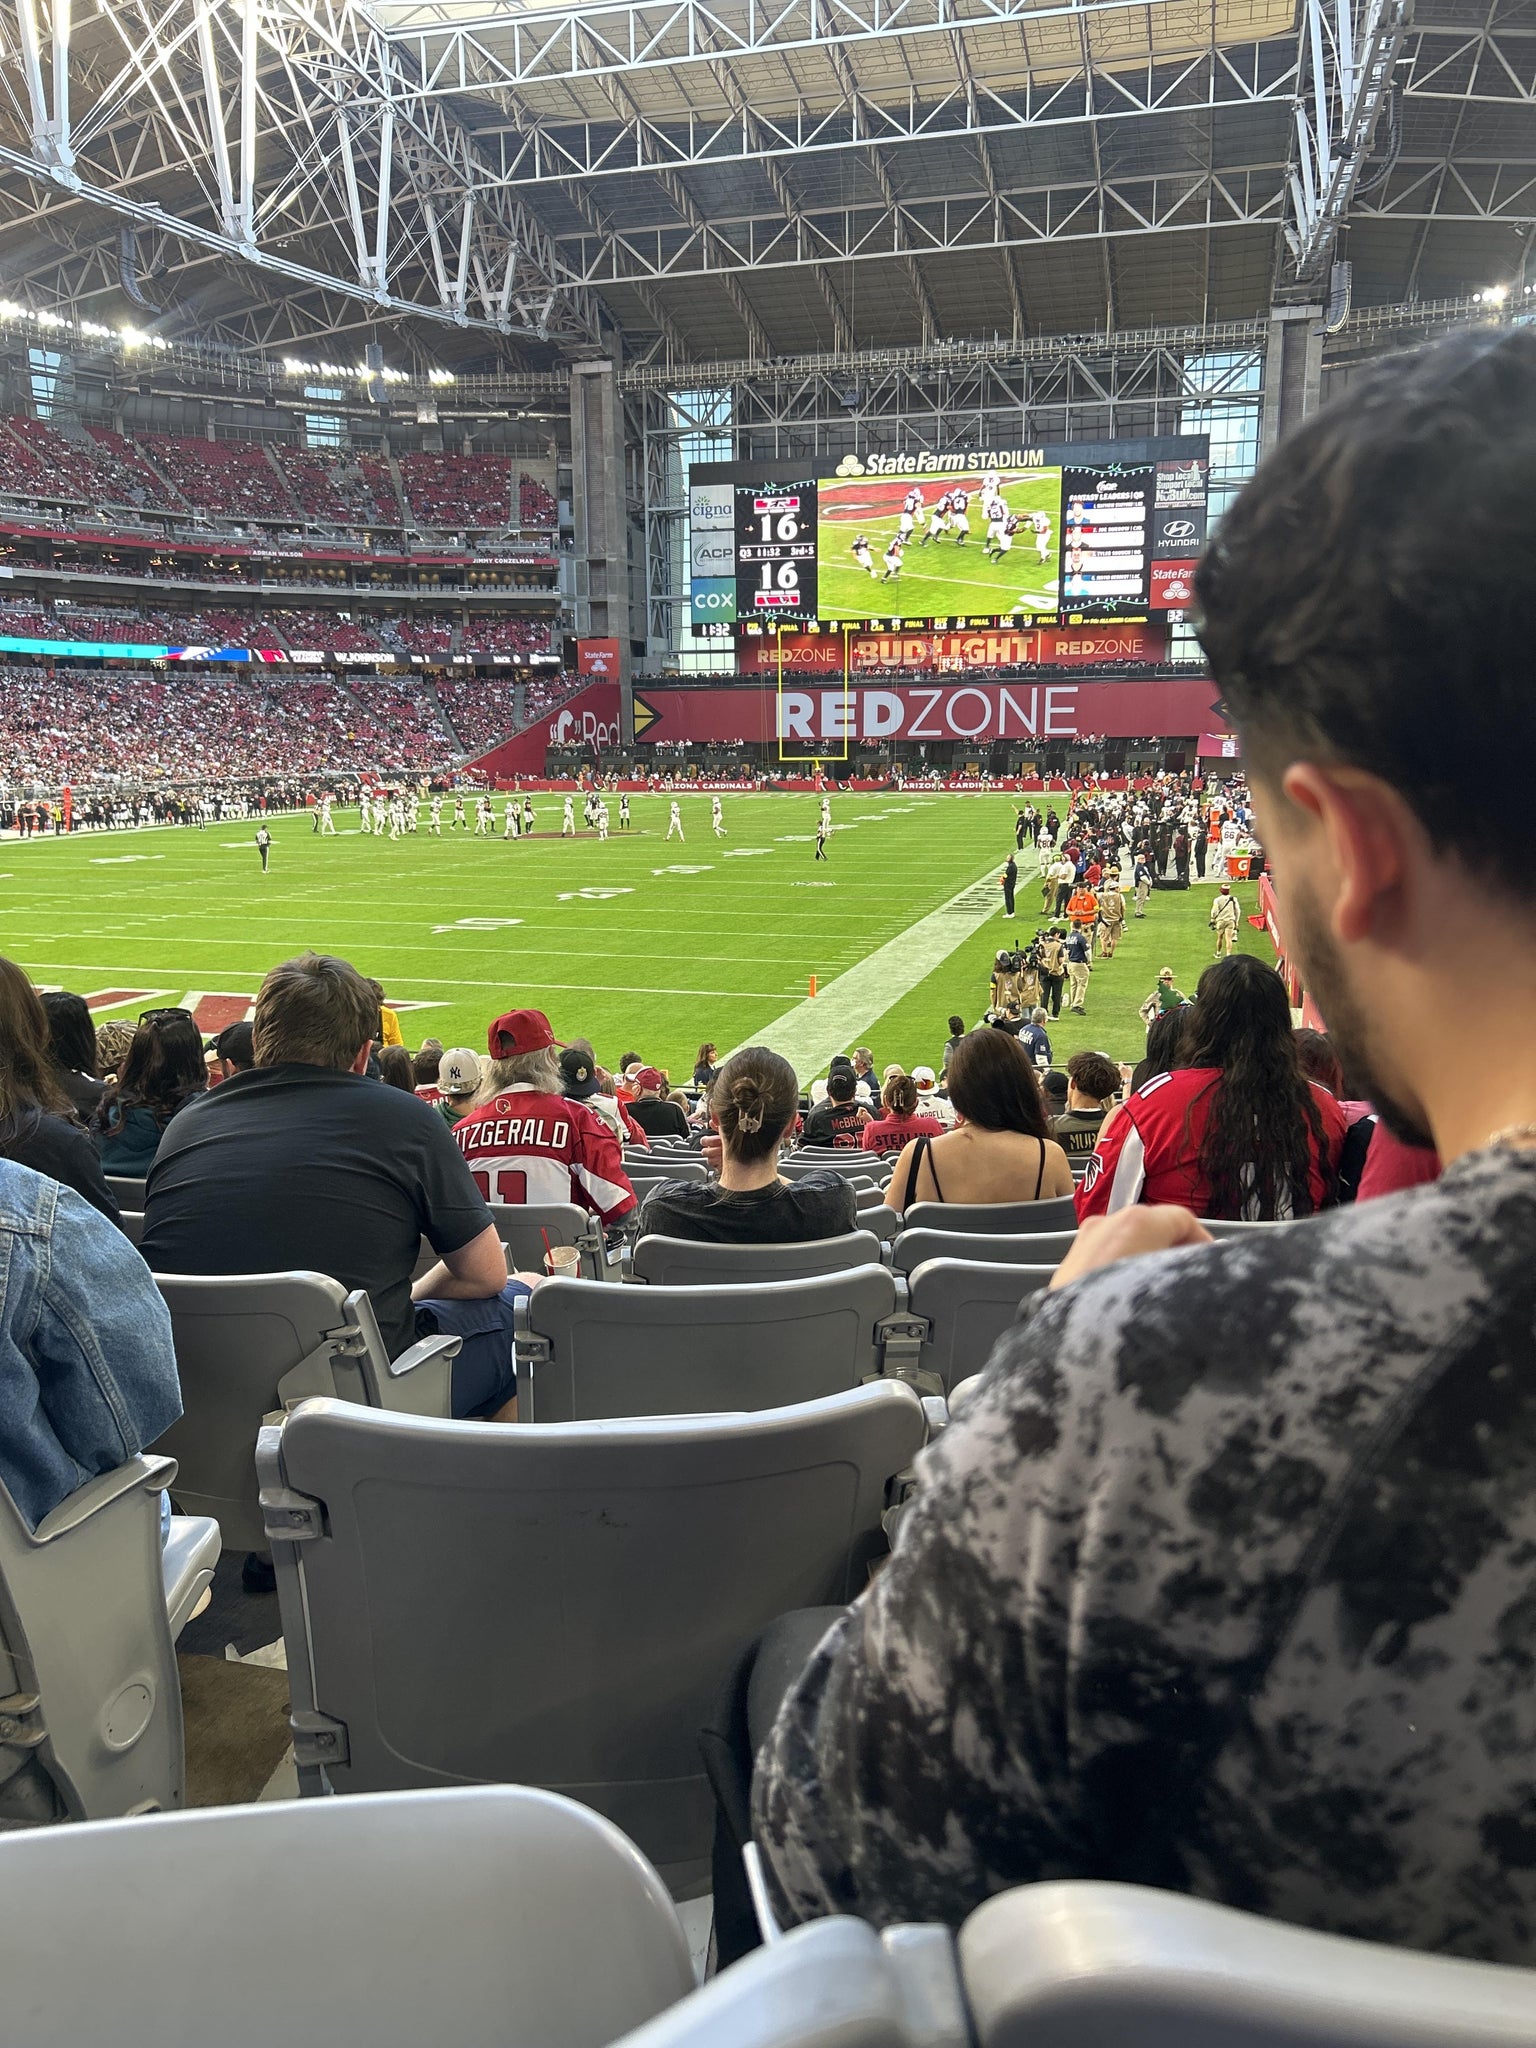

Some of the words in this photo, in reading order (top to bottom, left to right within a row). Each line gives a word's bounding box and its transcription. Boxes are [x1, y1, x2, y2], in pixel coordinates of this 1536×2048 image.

[968, 450, 1044, 470] STADIUM
[1156, 473, 1174, 481] Shop
[1156, 481, 1184, 489] Support
[1185, 479, 1203, 488] Local
[693, 503, 732, 519] cigna
[761, 513, 798, 541] 16
[1158, 538, 1200, 547] HYUNDAI
[700, 548, 733, 559] ACP
[740, 549, 752, 558] Q3
[757, 547, 780, 557] 11:32
[761, 561, 798, 589] 16
[1152, 569, 1197, 580] StateFar
[695, 592, 734, 608] COX
[904, 620, 925, 628] FINAL
[969, 618, 990, 626] FINAL
[1037, 616, 1058, 624] FINAL
[702, 623, 729, 636] 11:32
[780, 624, 799, 632] FINAL
[842, 622, 861, 630] FINAL
[857, 640, 926, 667] BUD
[932, 637, 1033, 664] LIGHT
[1237, 860, 1248, 871] G
[555, 887, 636, 901] 20
[429, 917, 526, 935] 10
[450, 1066, 461, 1079] NY
[452, 1118, 569, 1153] ITZGERALD
